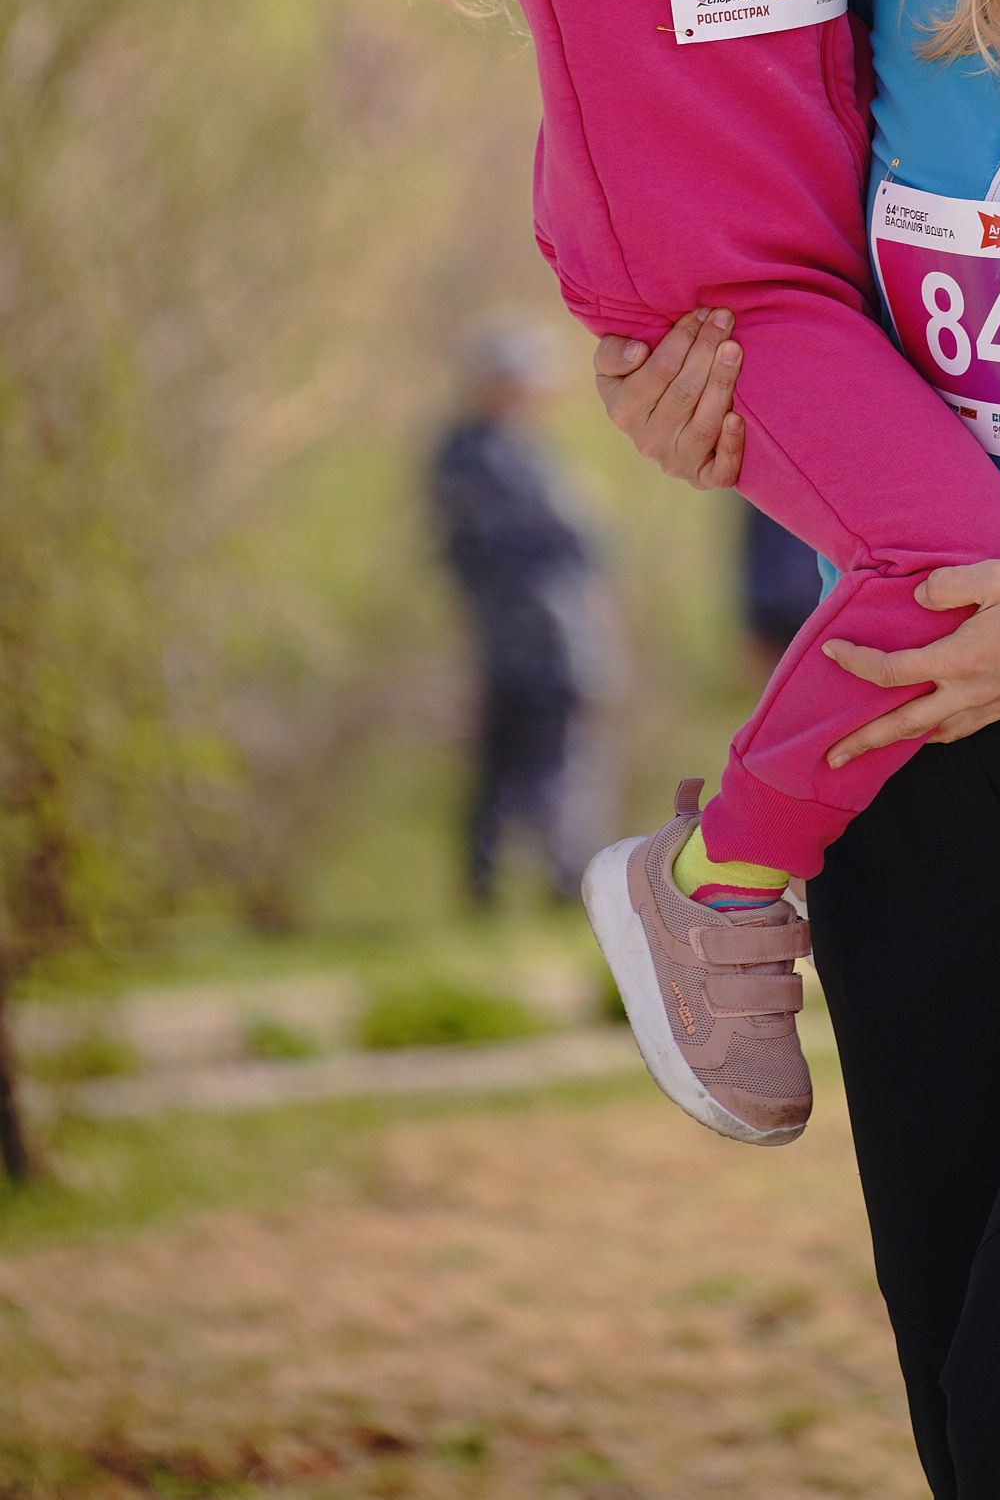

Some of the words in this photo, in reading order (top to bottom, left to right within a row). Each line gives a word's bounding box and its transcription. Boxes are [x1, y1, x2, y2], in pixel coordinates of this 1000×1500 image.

[697, 5, 770, 26] РОСГОССТРАХ
[900, 207, 929, 223] ПРОБЕГ
[885, 216, 923, 234] ВАСИЛИЯ
